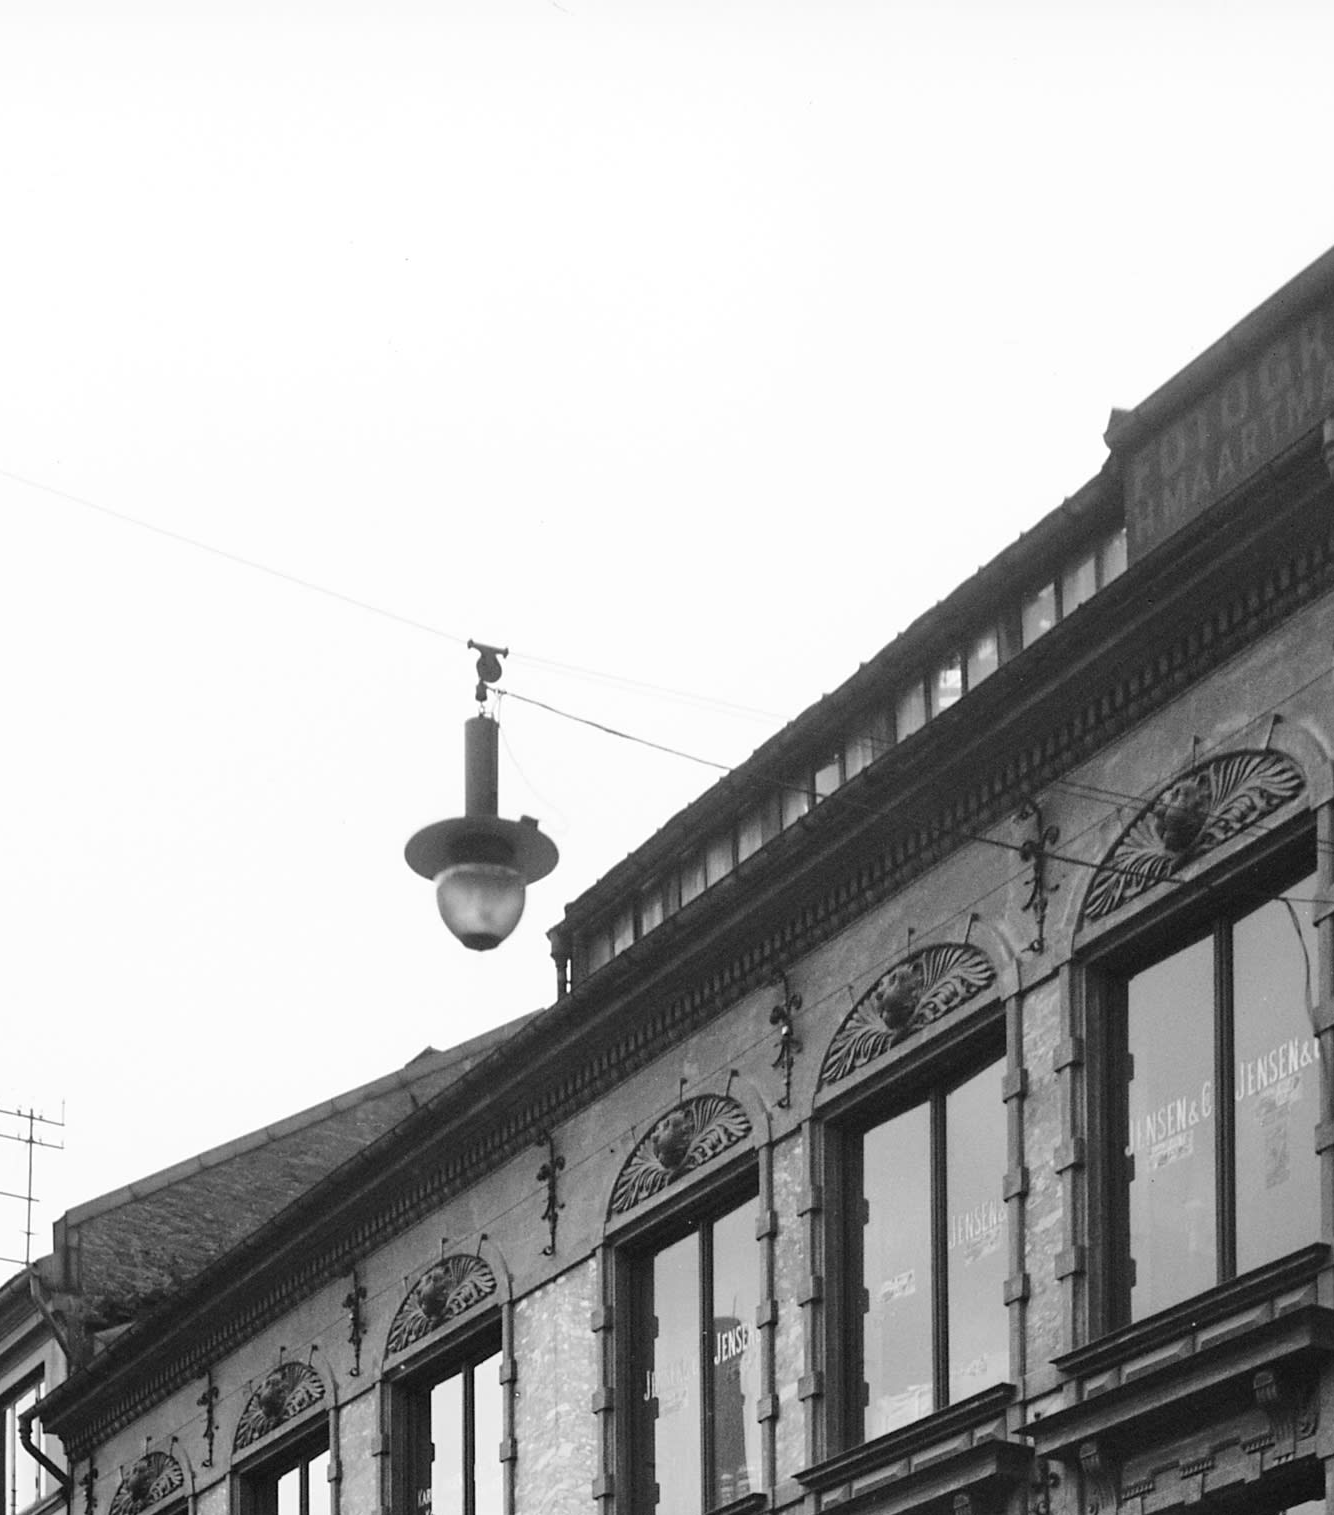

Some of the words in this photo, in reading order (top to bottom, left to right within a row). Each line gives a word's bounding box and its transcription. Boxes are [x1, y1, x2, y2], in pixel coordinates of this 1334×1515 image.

[1235, 1037, 1299, 1101] JENSEN
[1299, 1041, 1313, 1067] &
[1125, 1096, 1187, 1158] JENSEN
[1188, 1100, 1201, 1125] &
[949, 1200, 997, 1249] JENSEN
